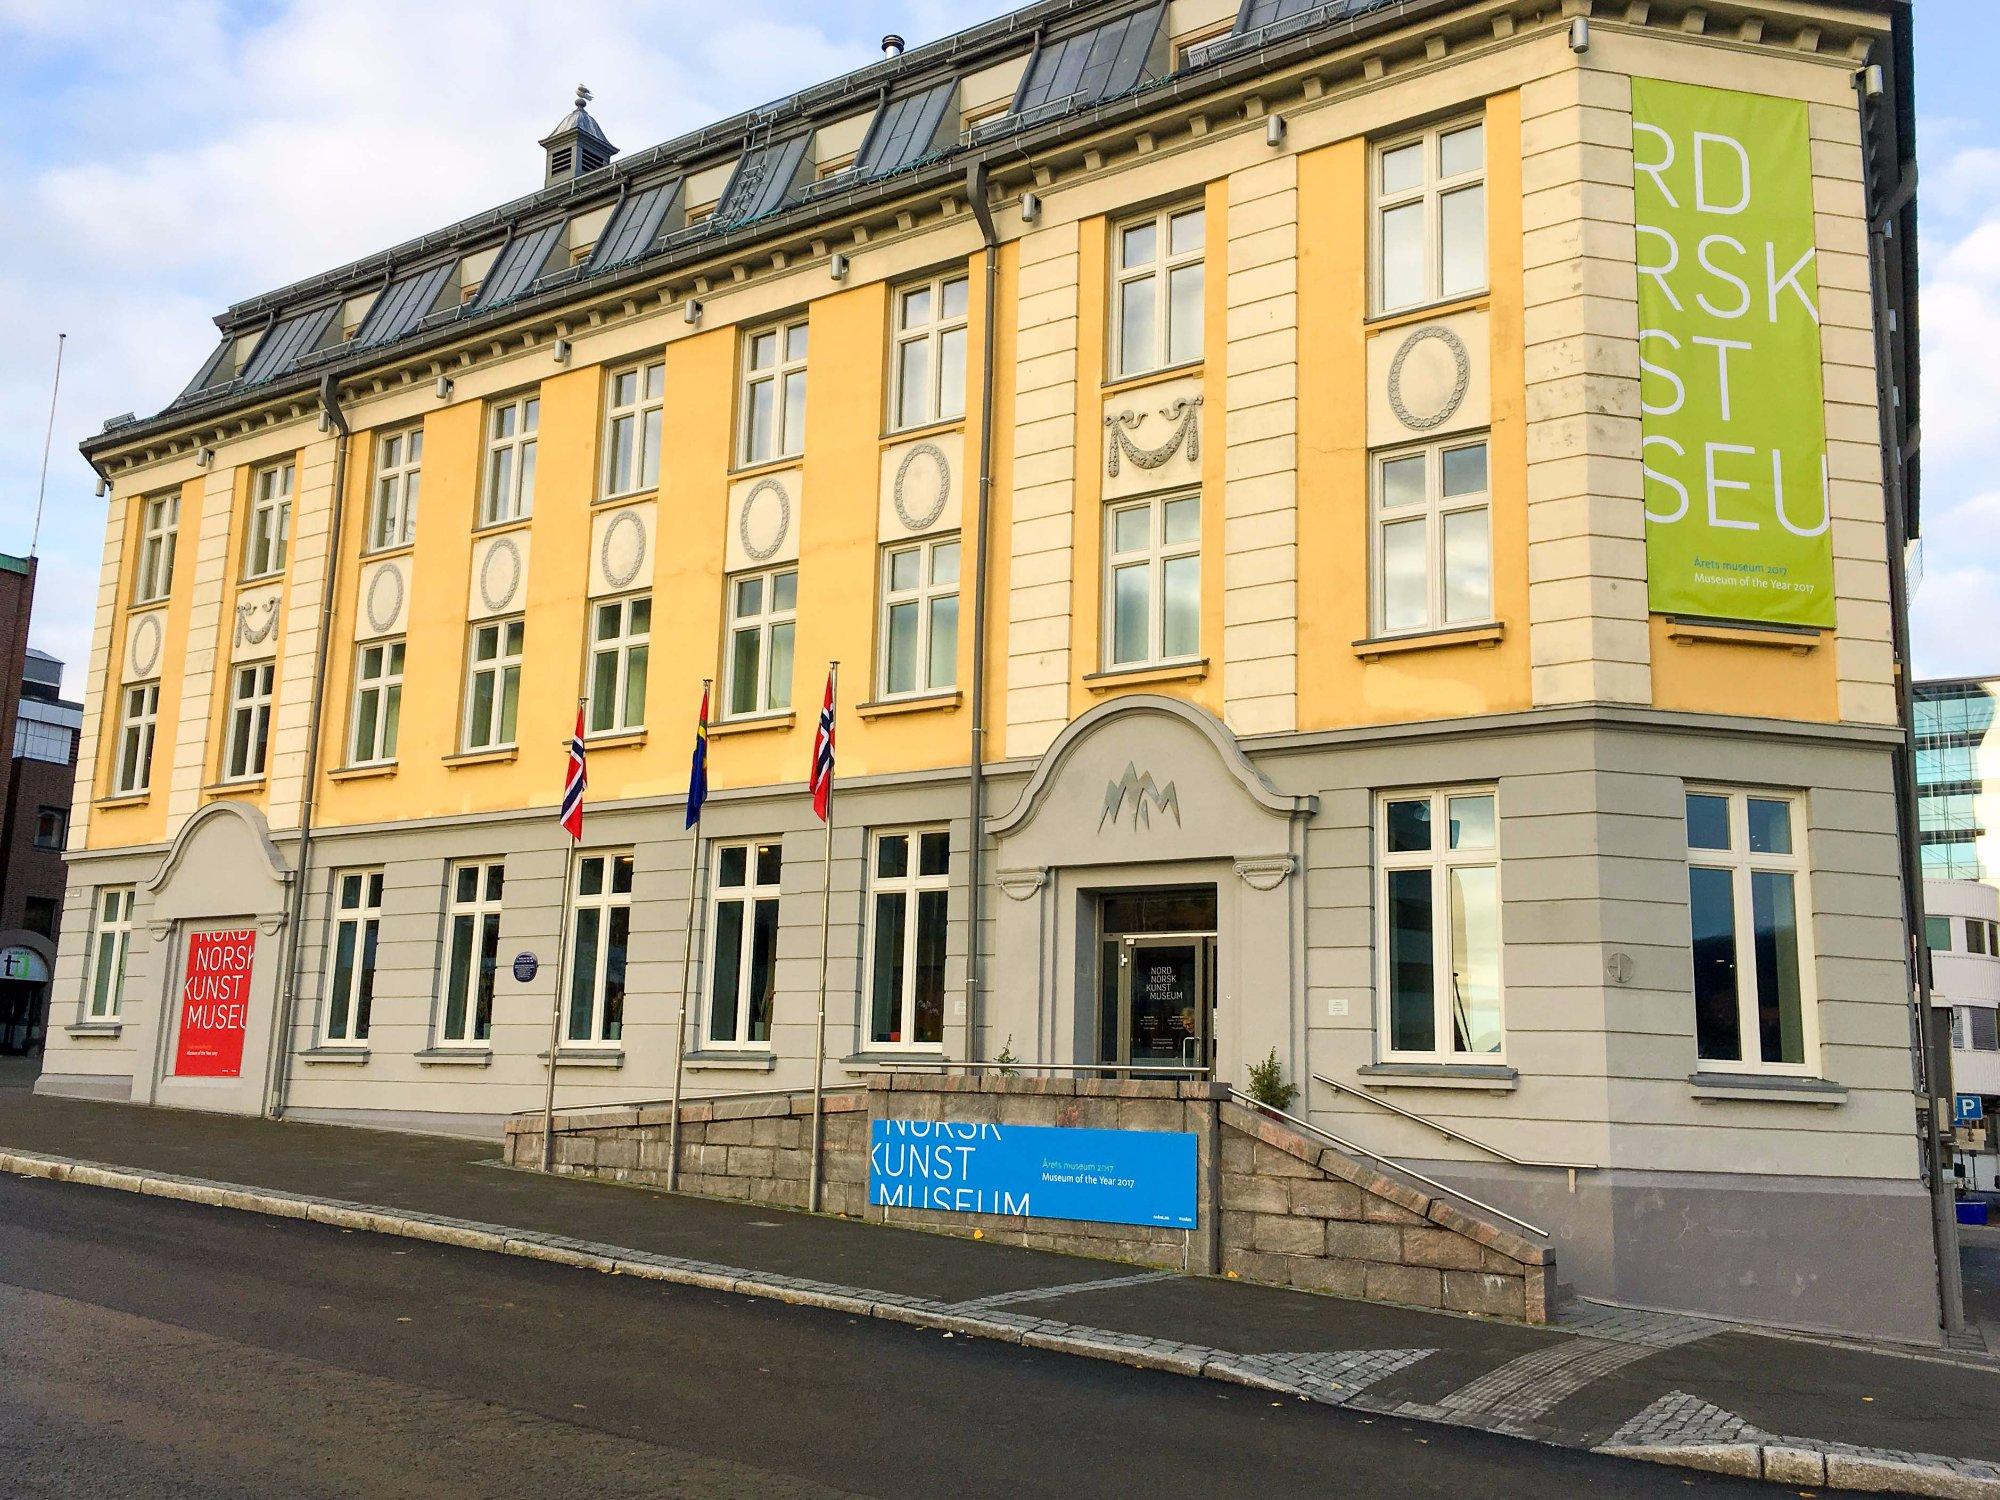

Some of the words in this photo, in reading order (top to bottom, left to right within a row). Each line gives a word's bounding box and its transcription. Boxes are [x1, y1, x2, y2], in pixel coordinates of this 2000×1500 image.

[1632, 121, 1751, 215] RD
[1639, 329, 1752, 421] ST
[1644, 435, 1831, 538] SEU
[1694, 555, 1720, 570] Årets
[1723, 561, 1764, 573] museum
[1767, 566, 1788, 576] 2017
[1694, 572, 1737, 586] Museum
[1739, 575, 1750, 587] of
[1751, 577, 1768, 588] the
[1770, 579, 1791, 591] Year
[1794, 583, 1815, 595] 2017
[1150, 966, 1172, 975] NORD
[1150, 974, 1177, 983] NORSK
[1146, 983, 1172, 991] KUNST
[1150, 991, 1183, 1000] MUSEUM
[1962, 1098, 1975, 1116] P
[1042, 1157, 1062, 1169] Årets
[1063, 1161, 1096, 1171] museum
[1042, 1172, 1074, 1183] Museum
[1075, 1173, 1084, 1184] of
[1084, 1174, 1098, 1185] the
[1099, 1175, 1116, 1187] Year
[1117, 1178, 1135, 1189] 2017
